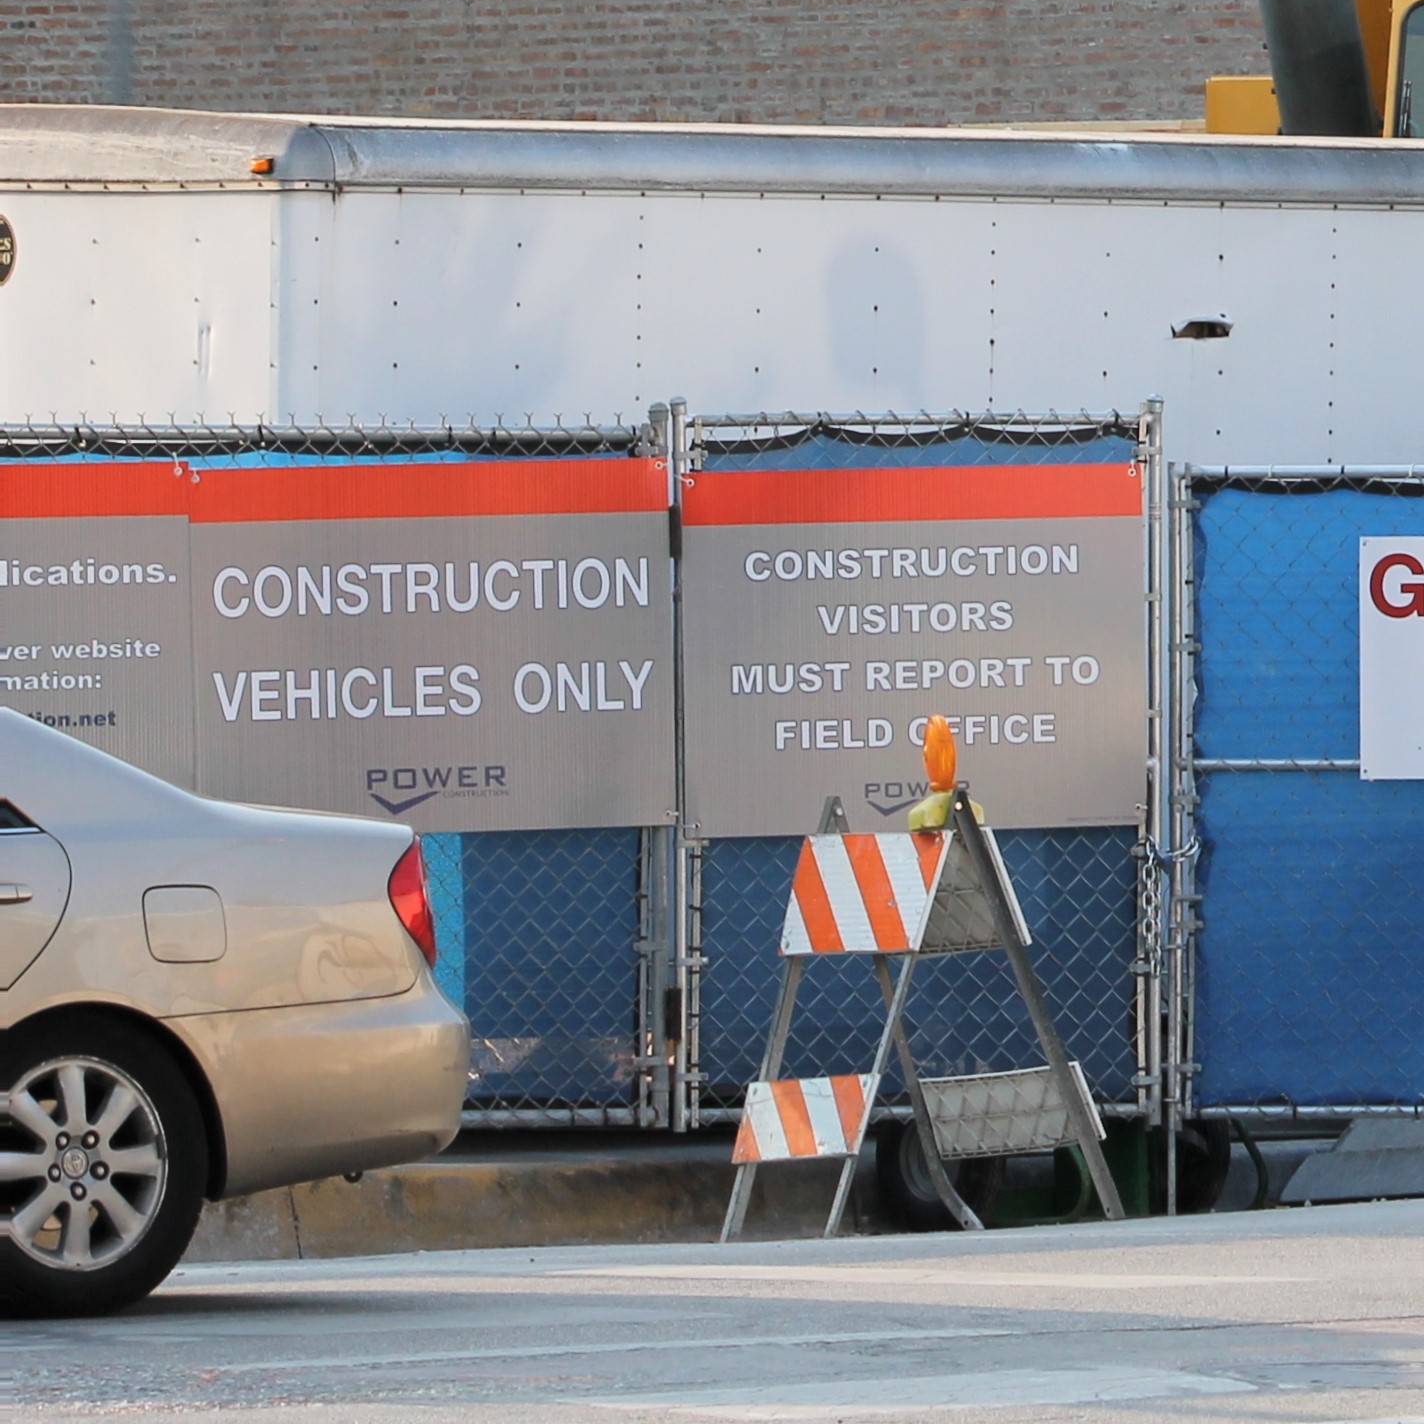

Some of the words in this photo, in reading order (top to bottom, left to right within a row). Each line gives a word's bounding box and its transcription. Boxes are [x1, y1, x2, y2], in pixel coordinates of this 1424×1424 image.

[744, 544, 1079, 581] CONSTRUCTION
[212, 556, 650, 619] CONSTRUCTION
[817, 601, 1014, 635] VISITORS
[51, 638, 161, 659] website
[212, 663, 482, 723] VEHICLES
[514, 659, 655, 714] ONLY
[730, 662, 850, 695] MUST
[865, 657, 1032, 691] REPORT
[1045, 655, 1100, 686] TO
[775, 718, 894, 751] FIELD
[366, 765, 507, 790] POWER
